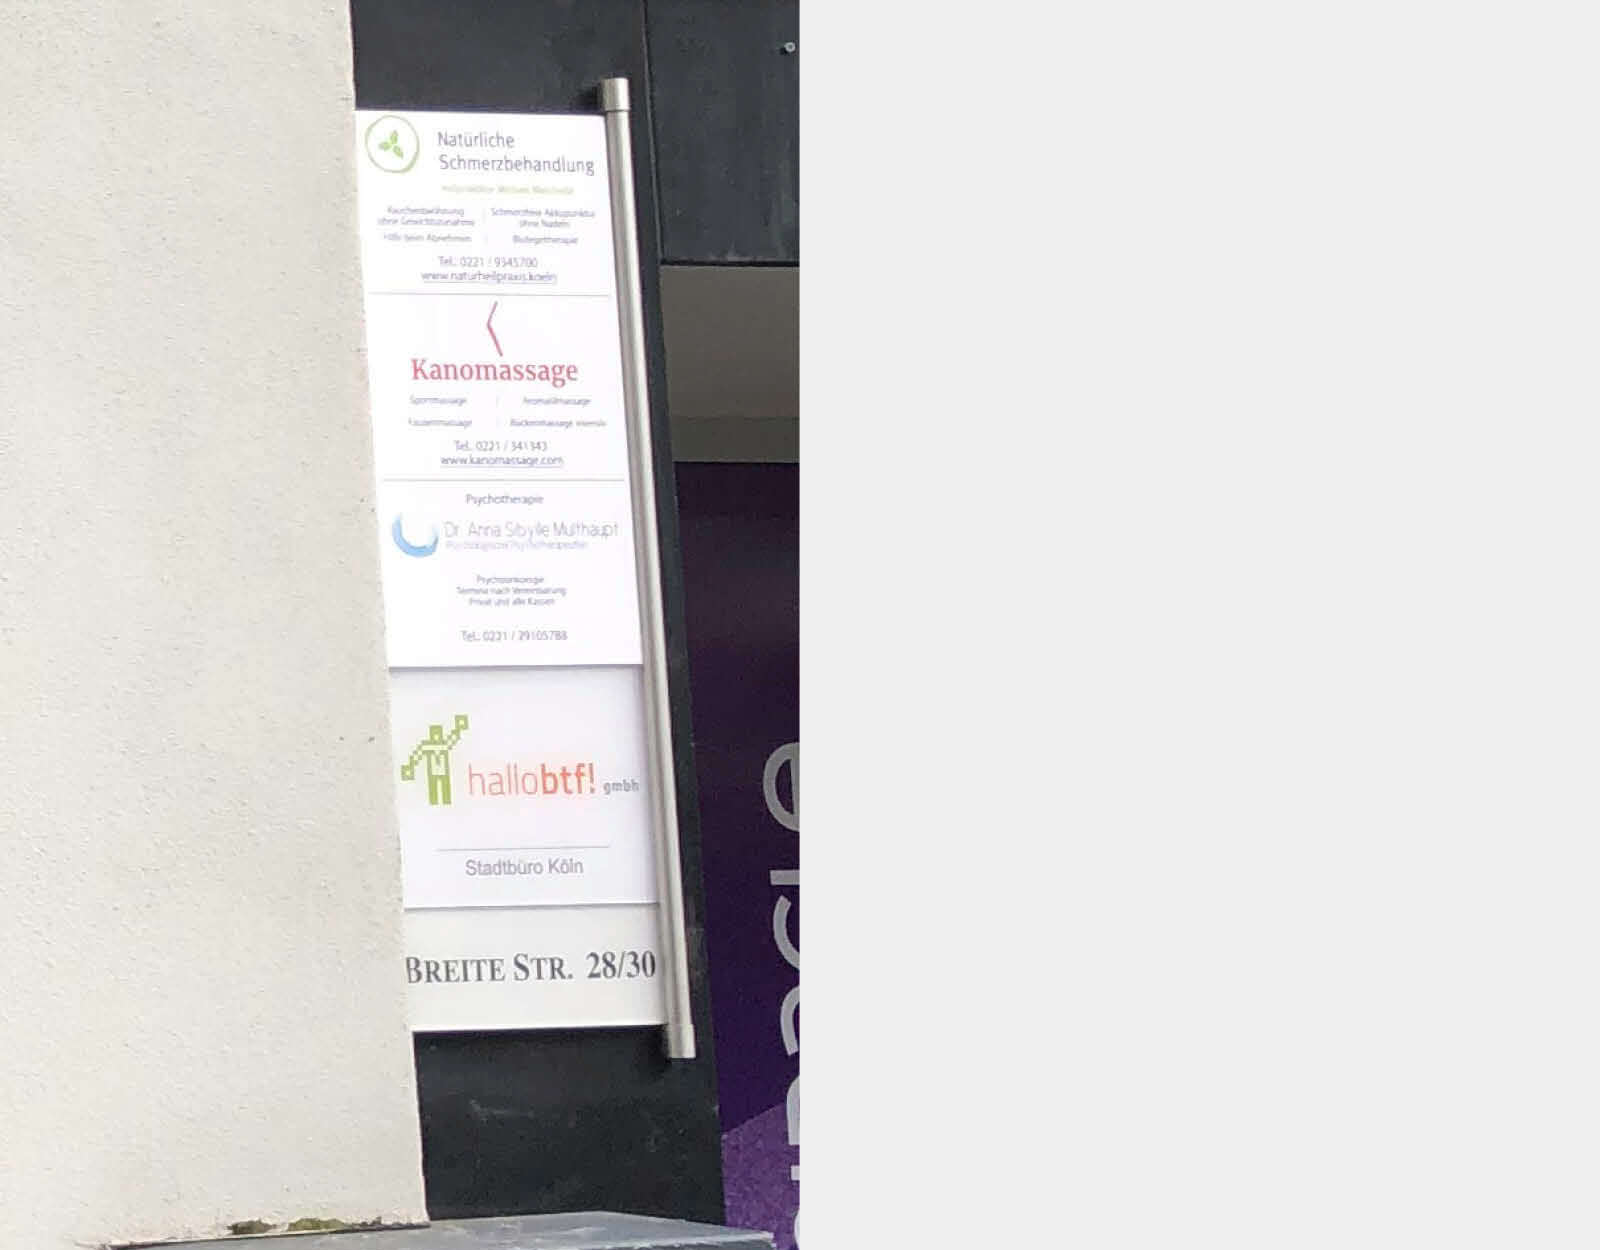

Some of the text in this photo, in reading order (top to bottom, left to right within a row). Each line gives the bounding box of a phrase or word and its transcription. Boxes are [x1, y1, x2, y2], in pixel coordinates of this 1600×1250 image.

[438, 131, 515, 148] Natürliche
[439, 154, 594, 176] Schmerzbehandlung
[460, 257, 484, 267] 0221
[410, 358, 578, 388] Kanomassage
[476, 441, 500, 451] 0221
[440, 456, 564, 467] www.kanomassage.com
[466, 494, 544, 506] Psychotherapie
[468, 522, 502, 537] Anna
[467, 762, 640, 796] hallobtf! gmbh
[465, 857, 584, 876] Stadtbüro Köln
[406, 950, 656, 984] BREITE STR. 28/30
